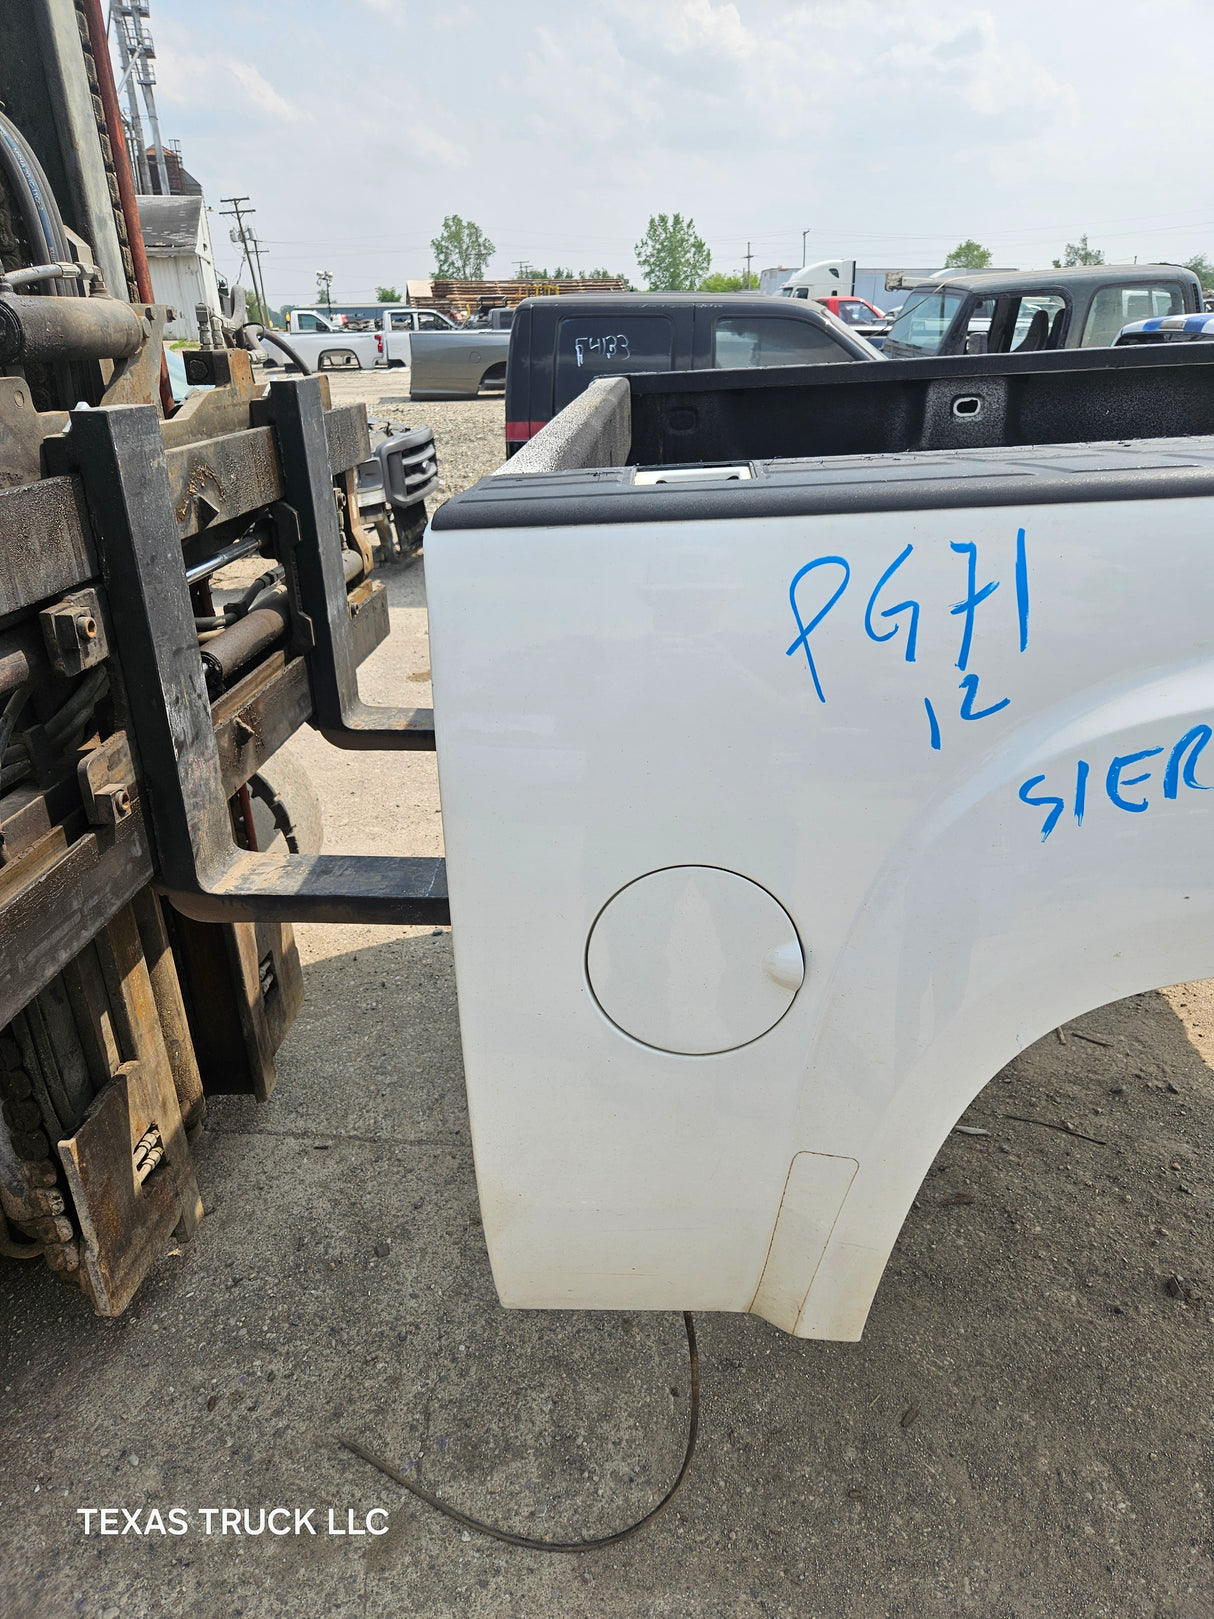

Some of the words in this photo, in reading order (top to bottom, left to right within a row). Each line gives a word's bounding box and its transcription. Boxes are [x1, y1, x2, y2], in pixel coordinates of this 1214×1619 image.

[785, 528, 1030, 704] PG71
[923, 673, 1011, 751] 12
[1018, 723, 1214, 843] SIER
